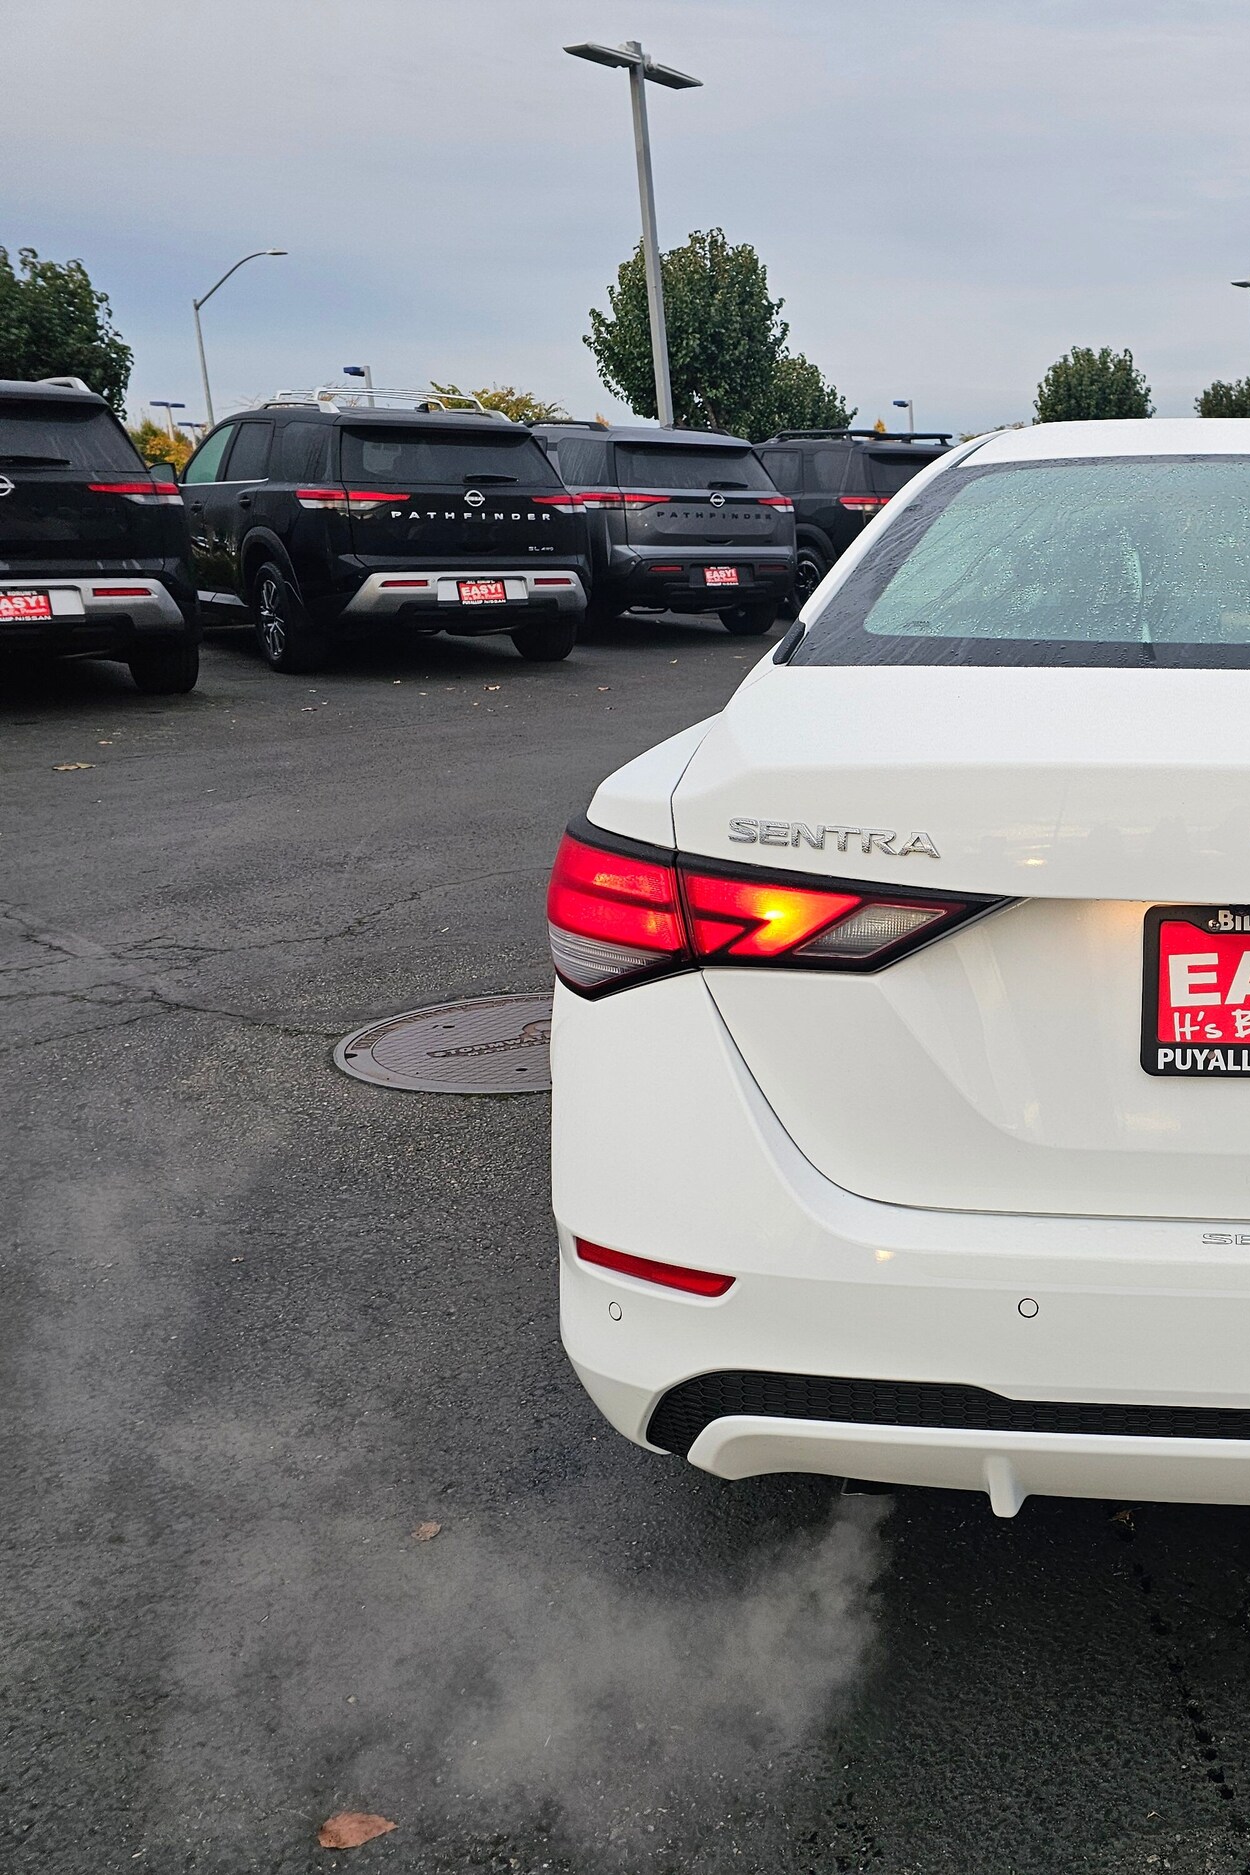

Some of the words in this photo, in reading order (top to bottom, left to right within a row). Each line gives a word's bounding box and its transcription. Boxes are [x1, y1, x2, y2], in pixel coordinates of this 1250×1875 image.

[390, 511, 551, 521] PATHFINDER
[656, 511, 772, 520] PATHFINDER
[704, 569, 737, 579] EASY!
[461, 583, 502, 596] EASY!
[0, 595, 46, 609] ASY!
[728, 817, 941, 859] SENTRA
[1173, 1010, 1223, 1042] It's
